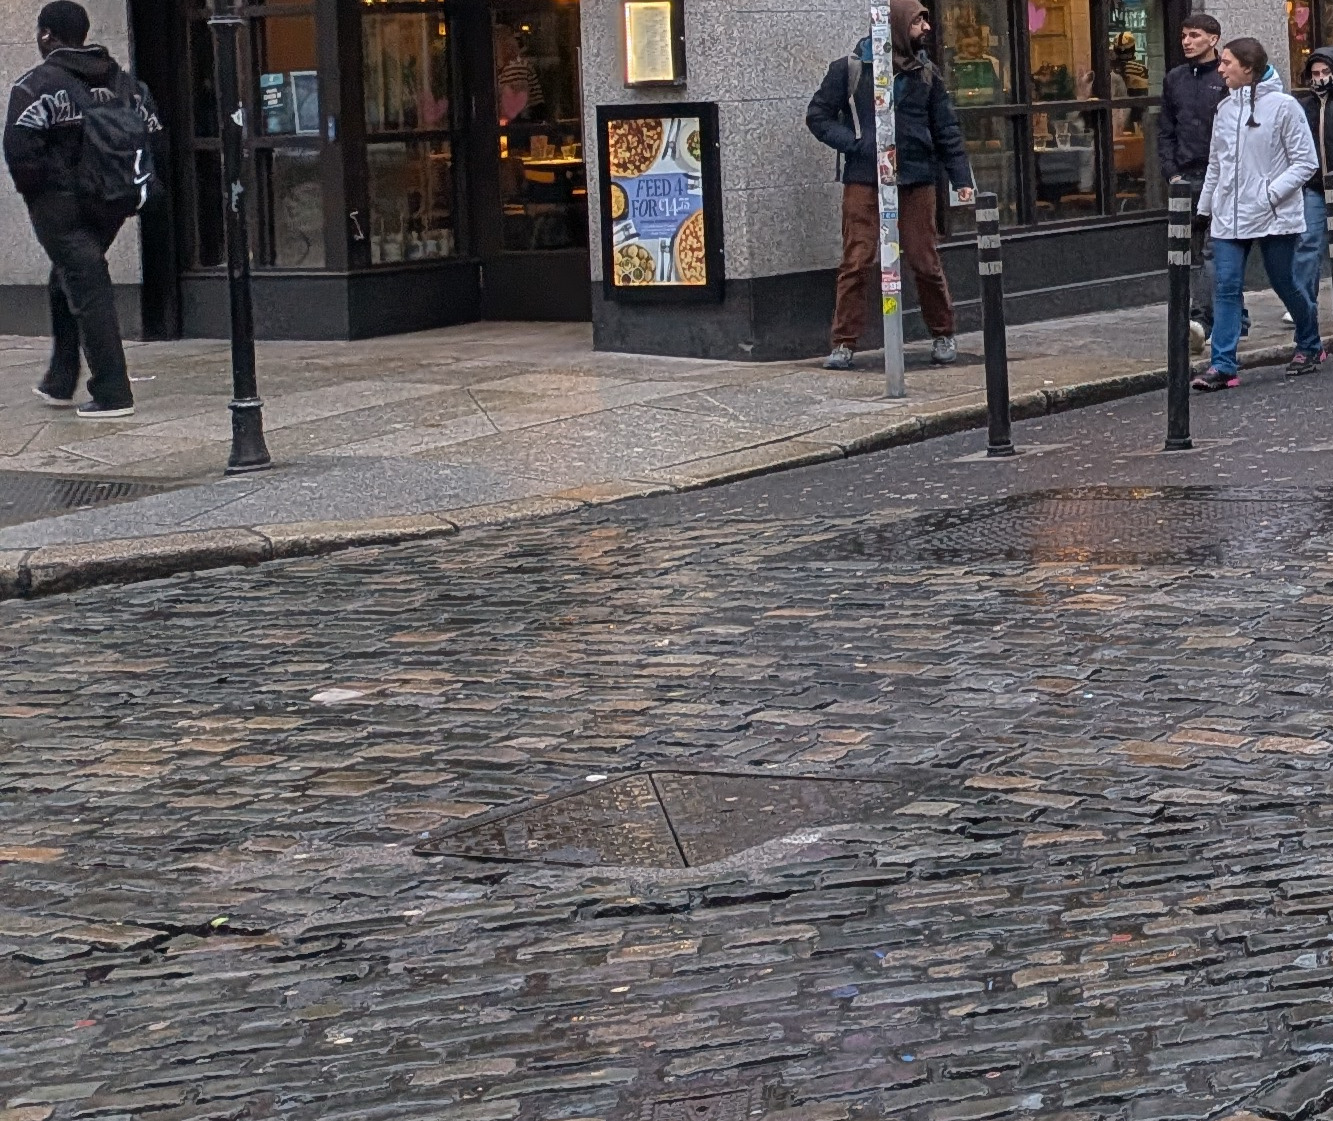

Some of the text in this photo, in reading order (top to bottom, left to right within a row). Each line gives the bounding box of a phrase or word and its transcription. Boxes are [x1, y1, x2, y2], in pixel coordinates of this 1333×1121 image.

[636, 177, 684, 198] FEED 4
[631, 198, 658, 218] FOR
